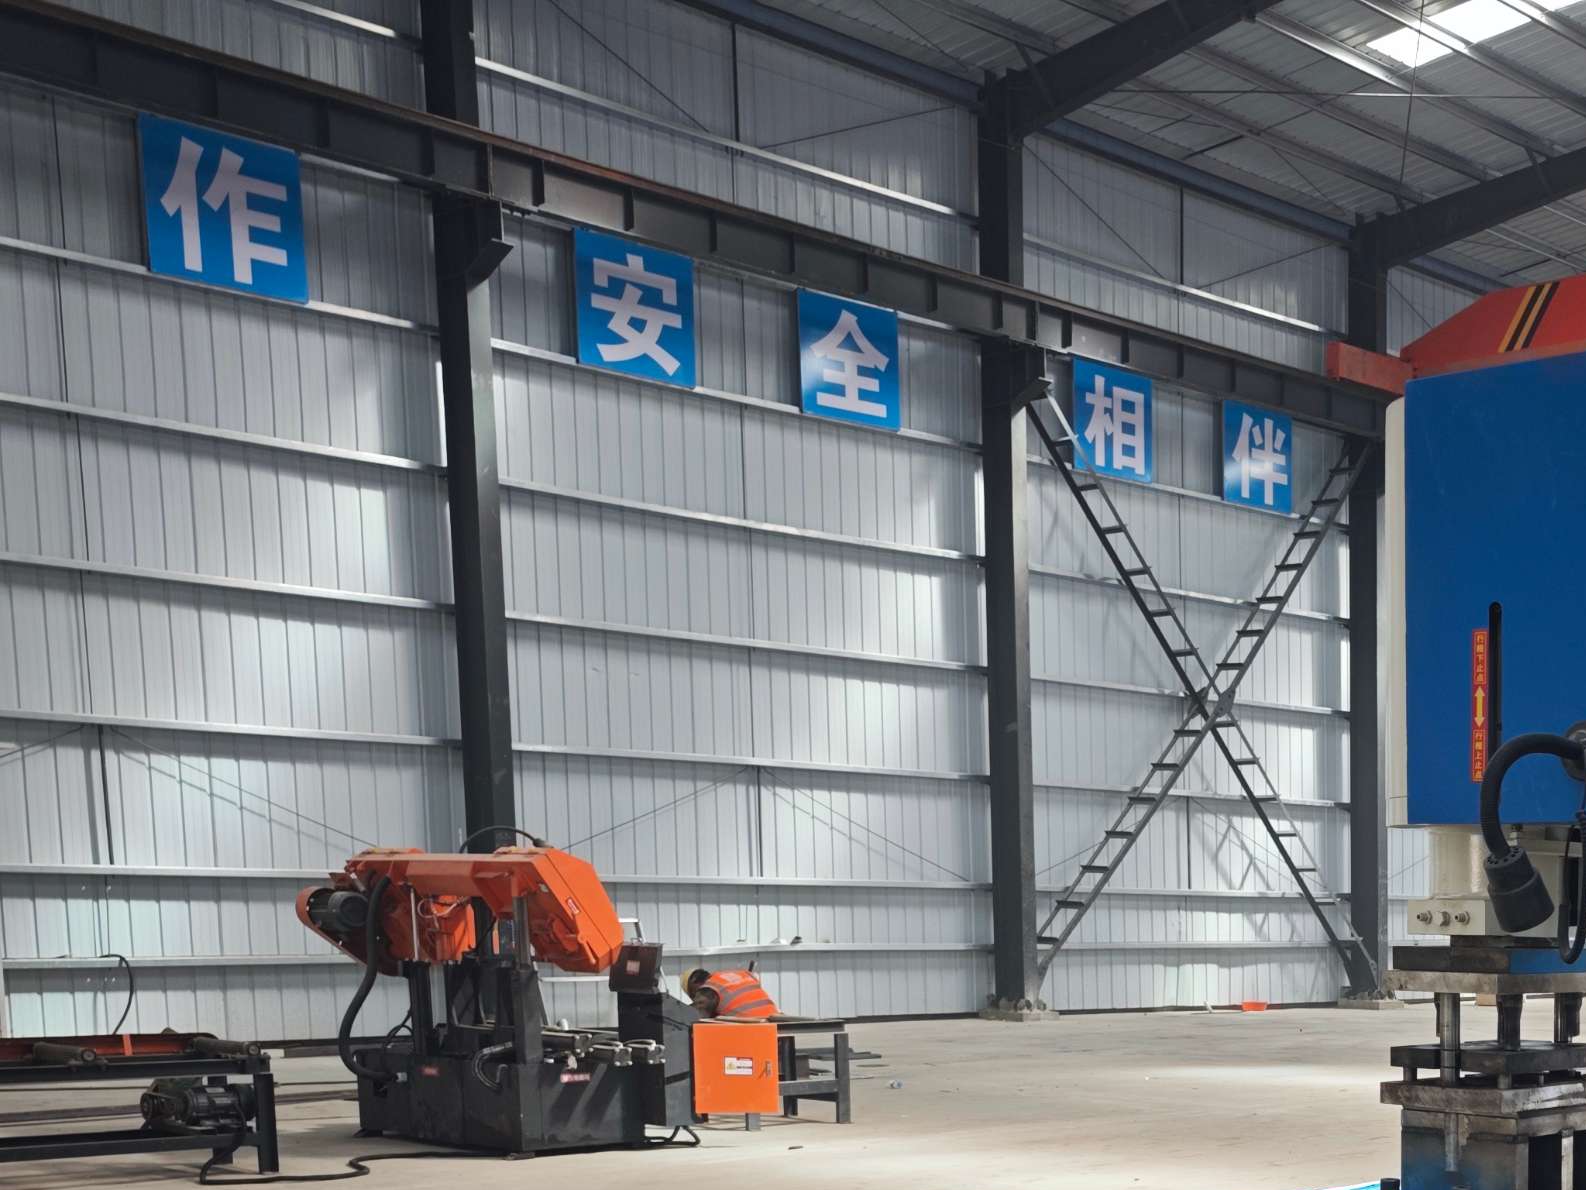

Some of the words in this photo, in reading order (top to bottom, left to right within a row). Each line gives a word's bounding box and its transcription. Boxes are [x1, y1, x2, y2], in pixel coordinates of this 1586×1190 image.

[160, 136, 288, 285] 作
[590, 253, 682, 377] 安
[809, 309, 889, 418] 全
[1084, 374, 1145, 476] 相
[1232, 412, 1288, 506] 伴
